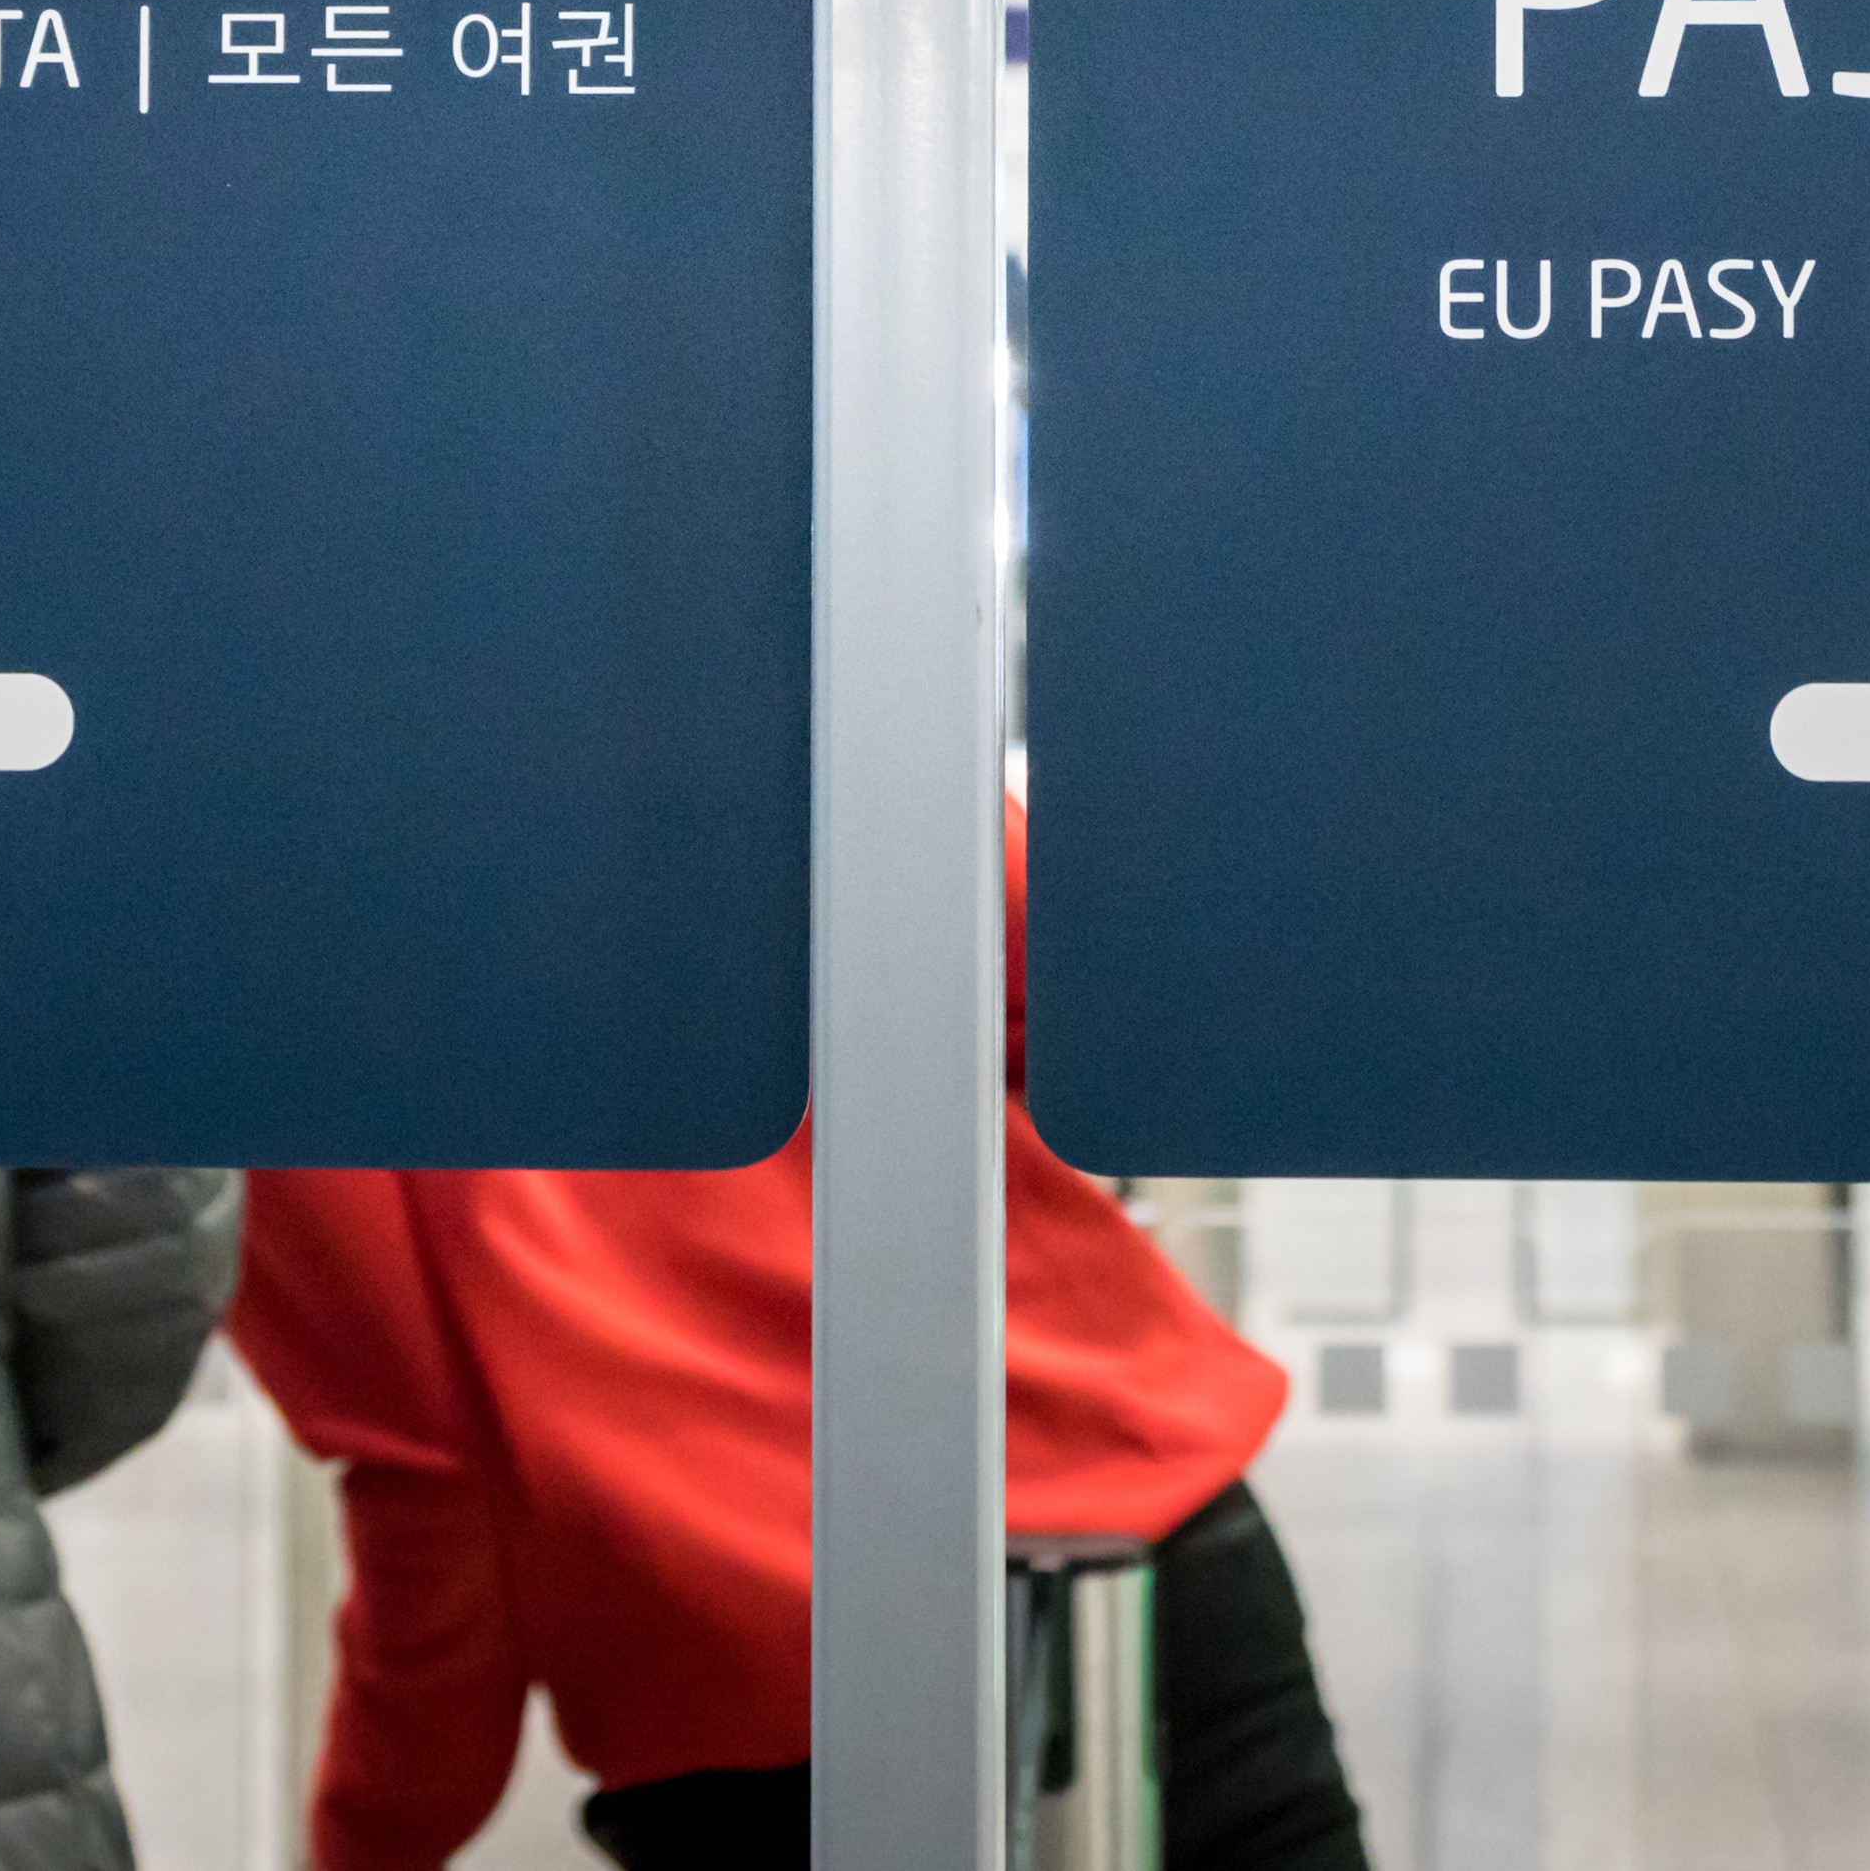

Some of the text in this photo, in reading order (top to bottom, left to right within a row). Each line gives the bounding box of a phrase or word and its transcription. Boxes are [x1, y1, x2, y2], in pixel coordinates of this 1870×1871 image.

[206, 0, 637, 97] 모든 여권
[1438, 257, 1817, 341] EU PASY
